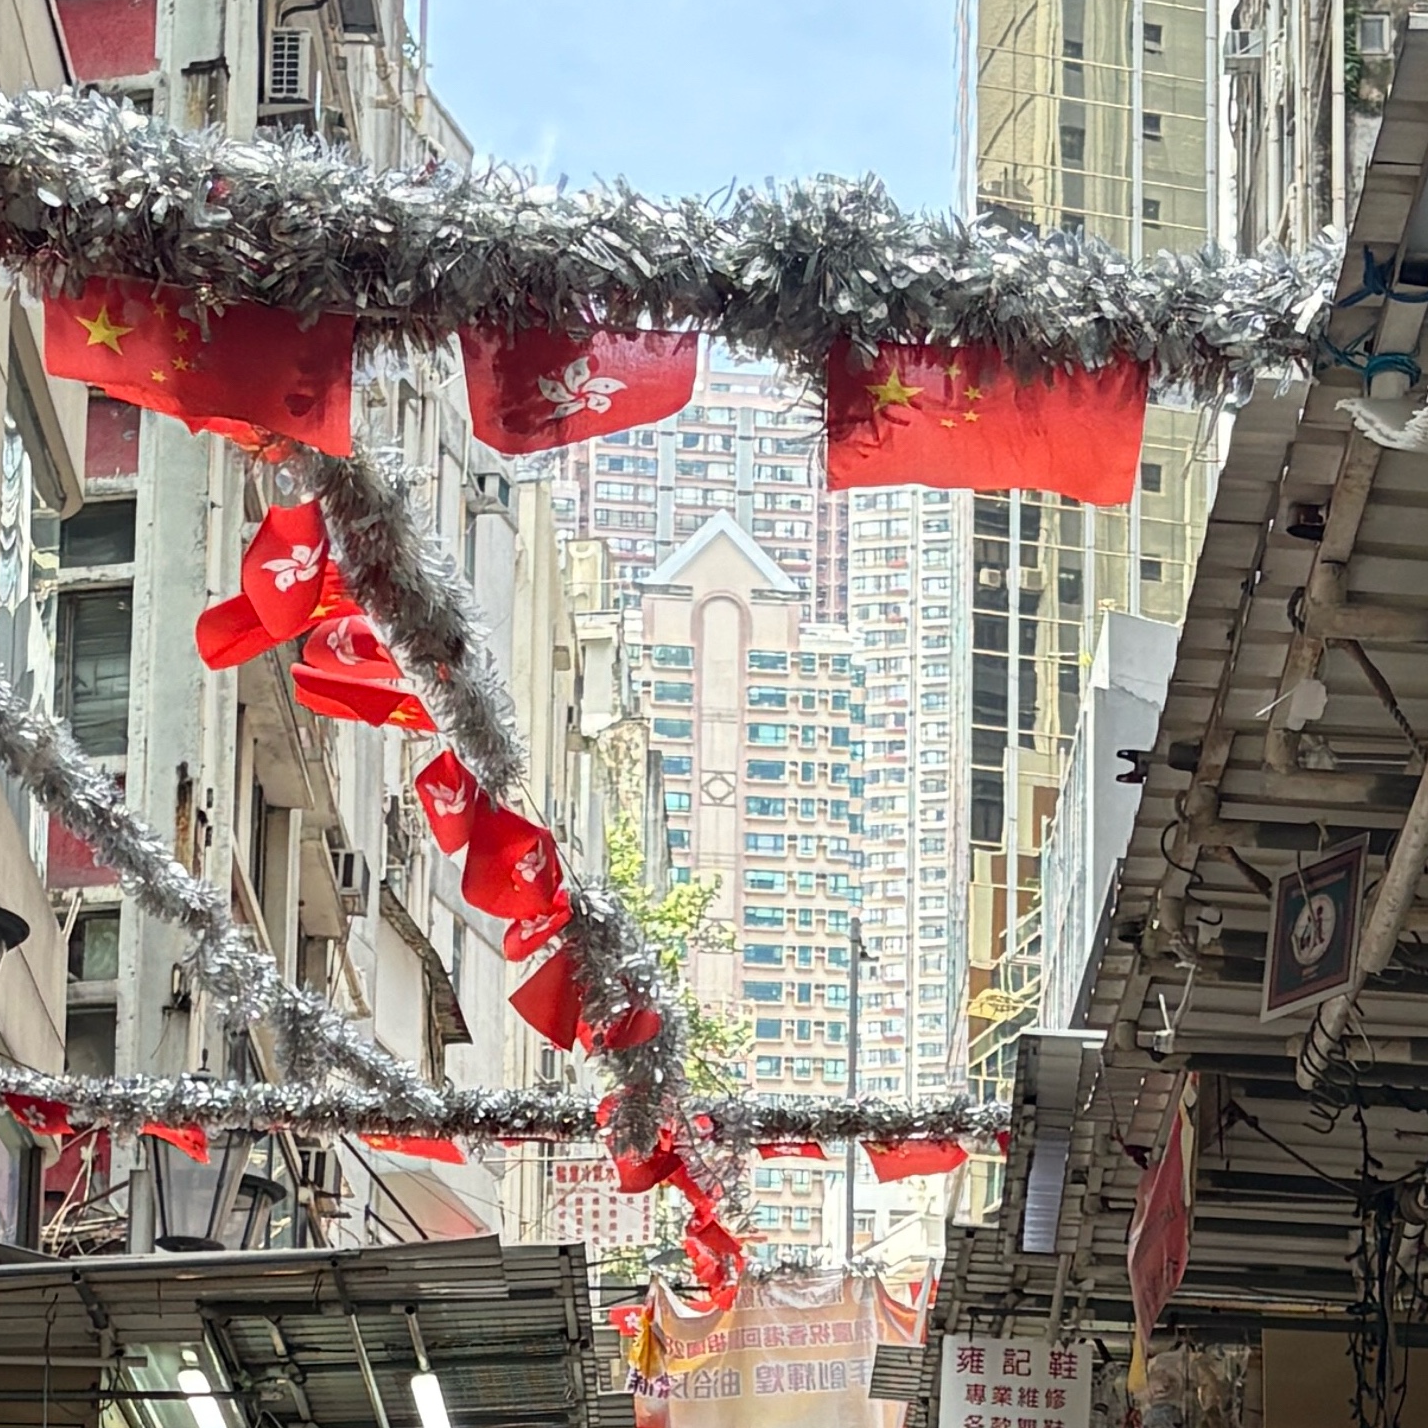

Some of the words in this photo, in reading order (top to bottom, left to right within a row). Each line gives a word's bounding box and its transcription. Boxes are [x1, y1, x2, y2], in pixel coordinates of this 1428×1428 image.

[957, 1347, 1078, 1379] 雍記鞋
[964, 1383, 1066, 1410] 專業維修
